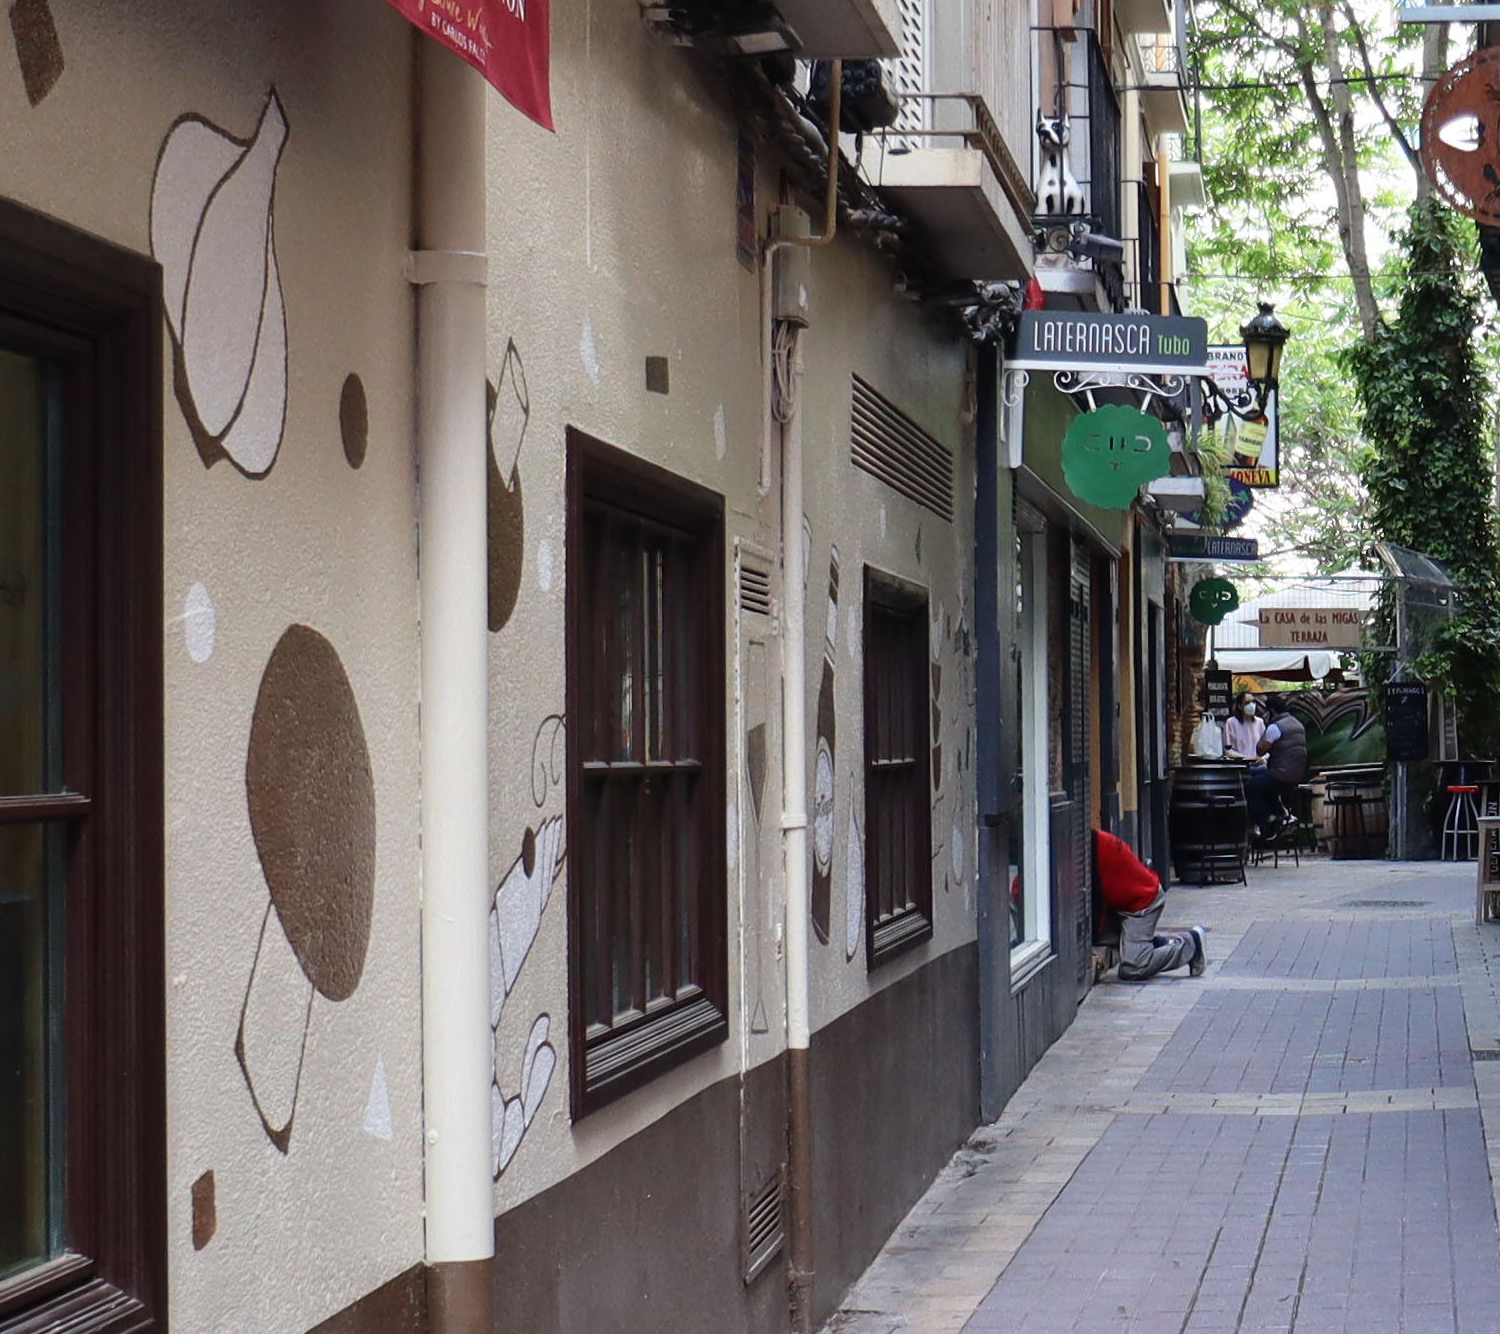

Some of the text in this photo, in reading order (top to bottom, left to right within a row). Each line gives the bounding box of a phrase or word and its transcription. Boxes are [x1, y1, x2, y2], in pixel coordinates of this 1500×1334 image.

[1034, 320, 1150, 356] LATERNASCA
[1208, 351, 1247, 362] BRAND
[1207, 539, 1258, 556] LATERNASCA
[1274, 611, 1296, 625] CASA
[1290, 630, 1329, 644] TERRAZA
